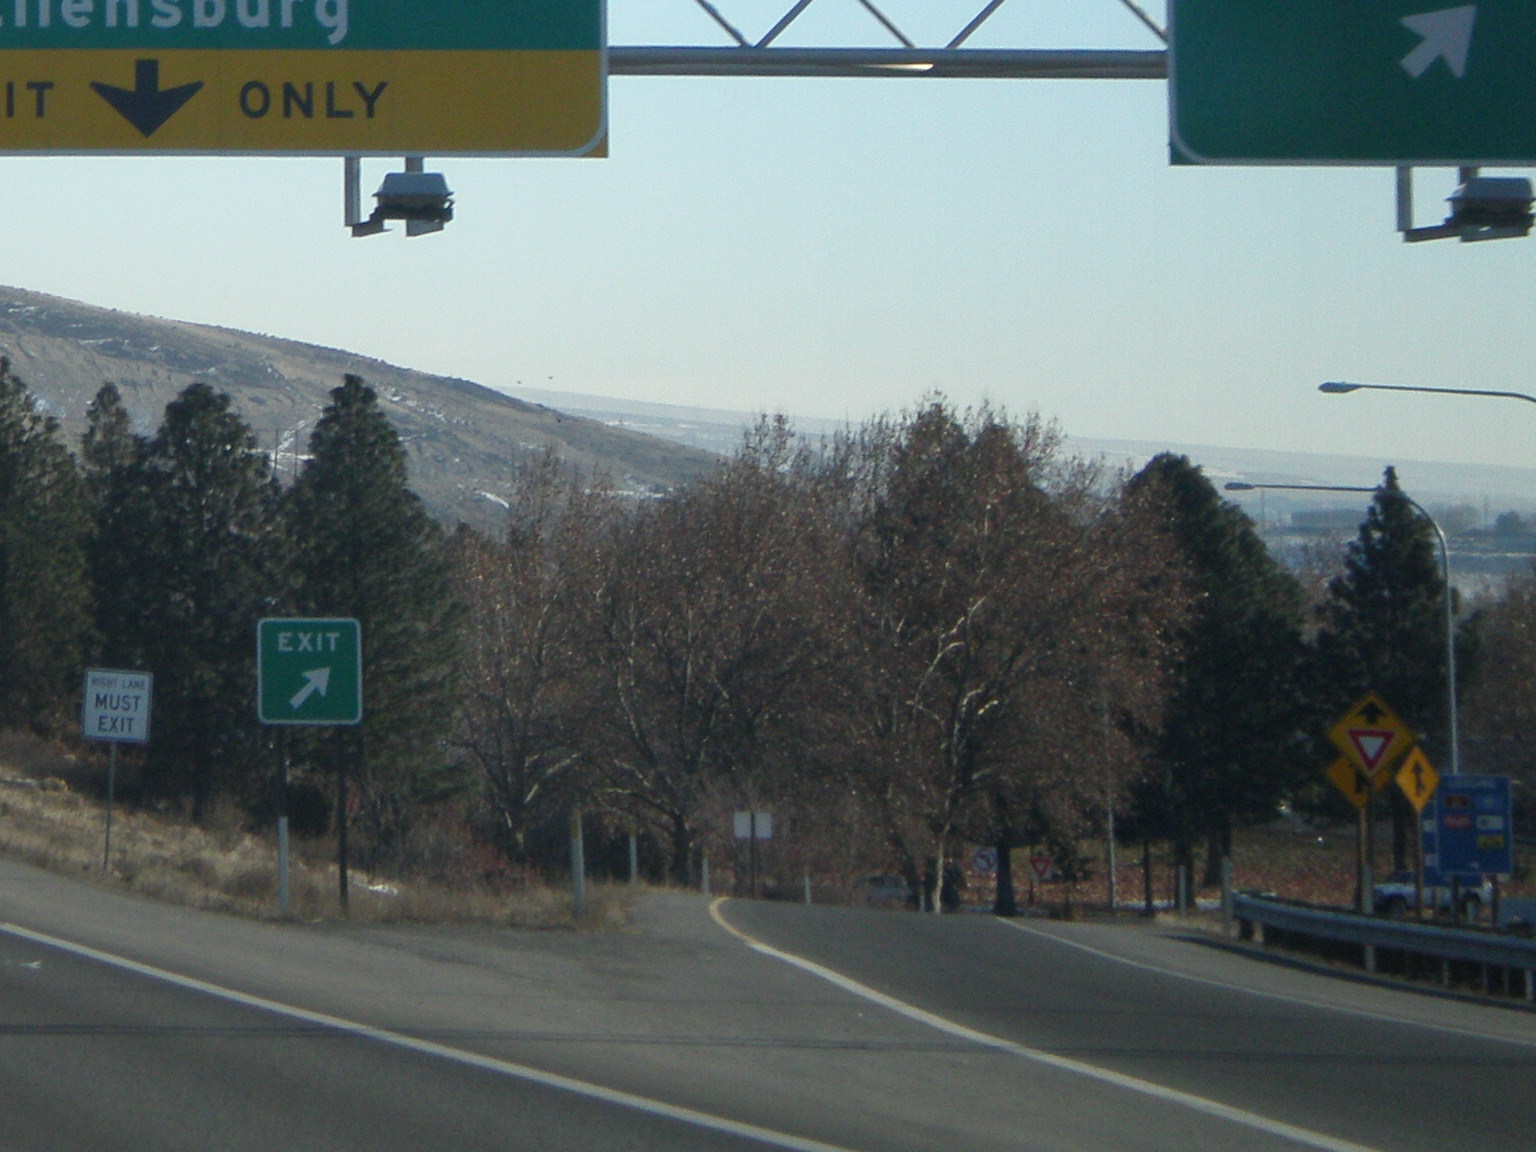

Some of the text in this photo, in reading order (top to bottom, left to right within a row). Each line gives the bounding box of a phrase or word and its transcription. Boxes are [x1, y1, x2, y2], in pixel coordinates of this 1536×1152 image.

[239, 81, 390, 119] ONLY
[278, 632, 340, 652] EXIT
[95, 693, 141, 711] MUST
[98, 715, 135, 734] EXIT
